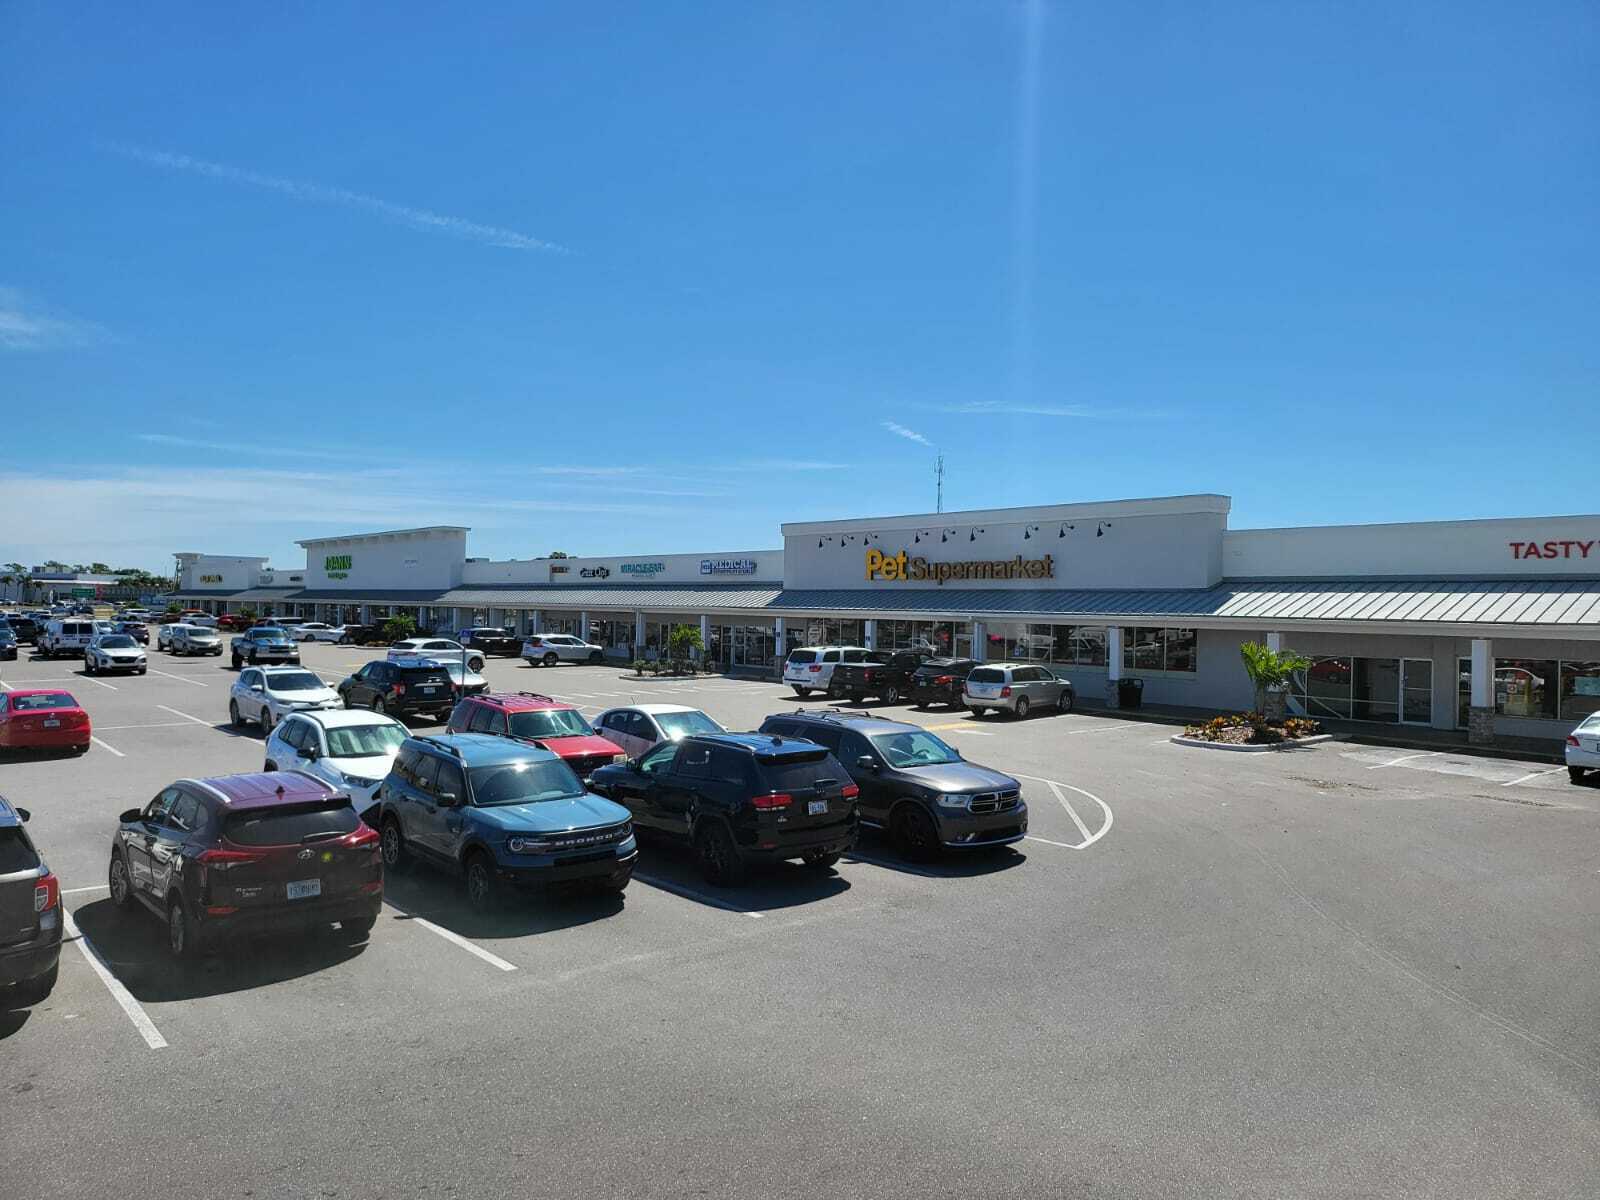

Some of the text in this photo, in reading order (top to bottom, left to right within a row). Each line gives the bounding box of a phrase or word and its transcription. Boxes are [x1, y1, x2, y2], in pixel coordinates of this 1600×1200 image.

[1509, 541, 1595, 559] TASTY
[711, 559, 753, 569] MEDICAL
[865, 549, 1054, 585] Pet Supermarket
